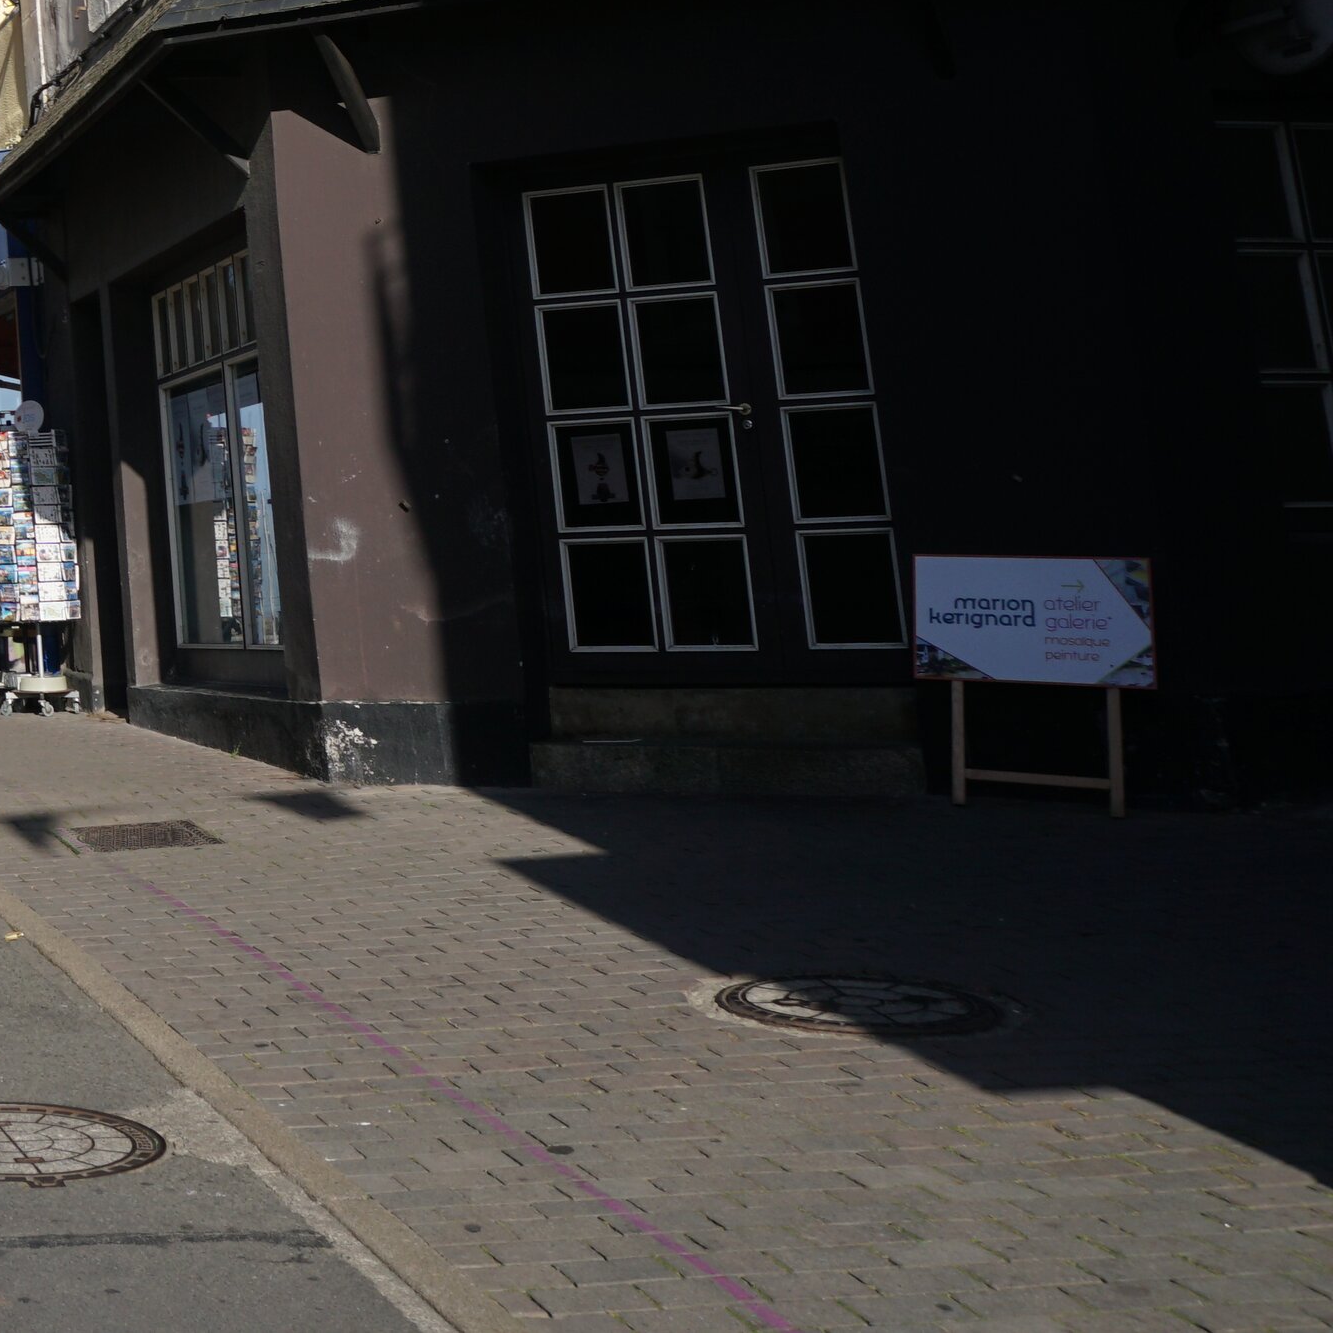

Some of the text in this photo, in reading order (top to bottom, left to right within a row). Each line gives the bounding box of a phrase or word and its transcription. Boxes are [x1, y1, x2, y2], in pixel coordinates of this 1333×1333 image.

[954, 597, 1035, 613] marion
[1043, 595, 1101, 612] atelier
[928, 607, 1036, 629] kerignard
[1045, 650, 1101, 662] peinture
